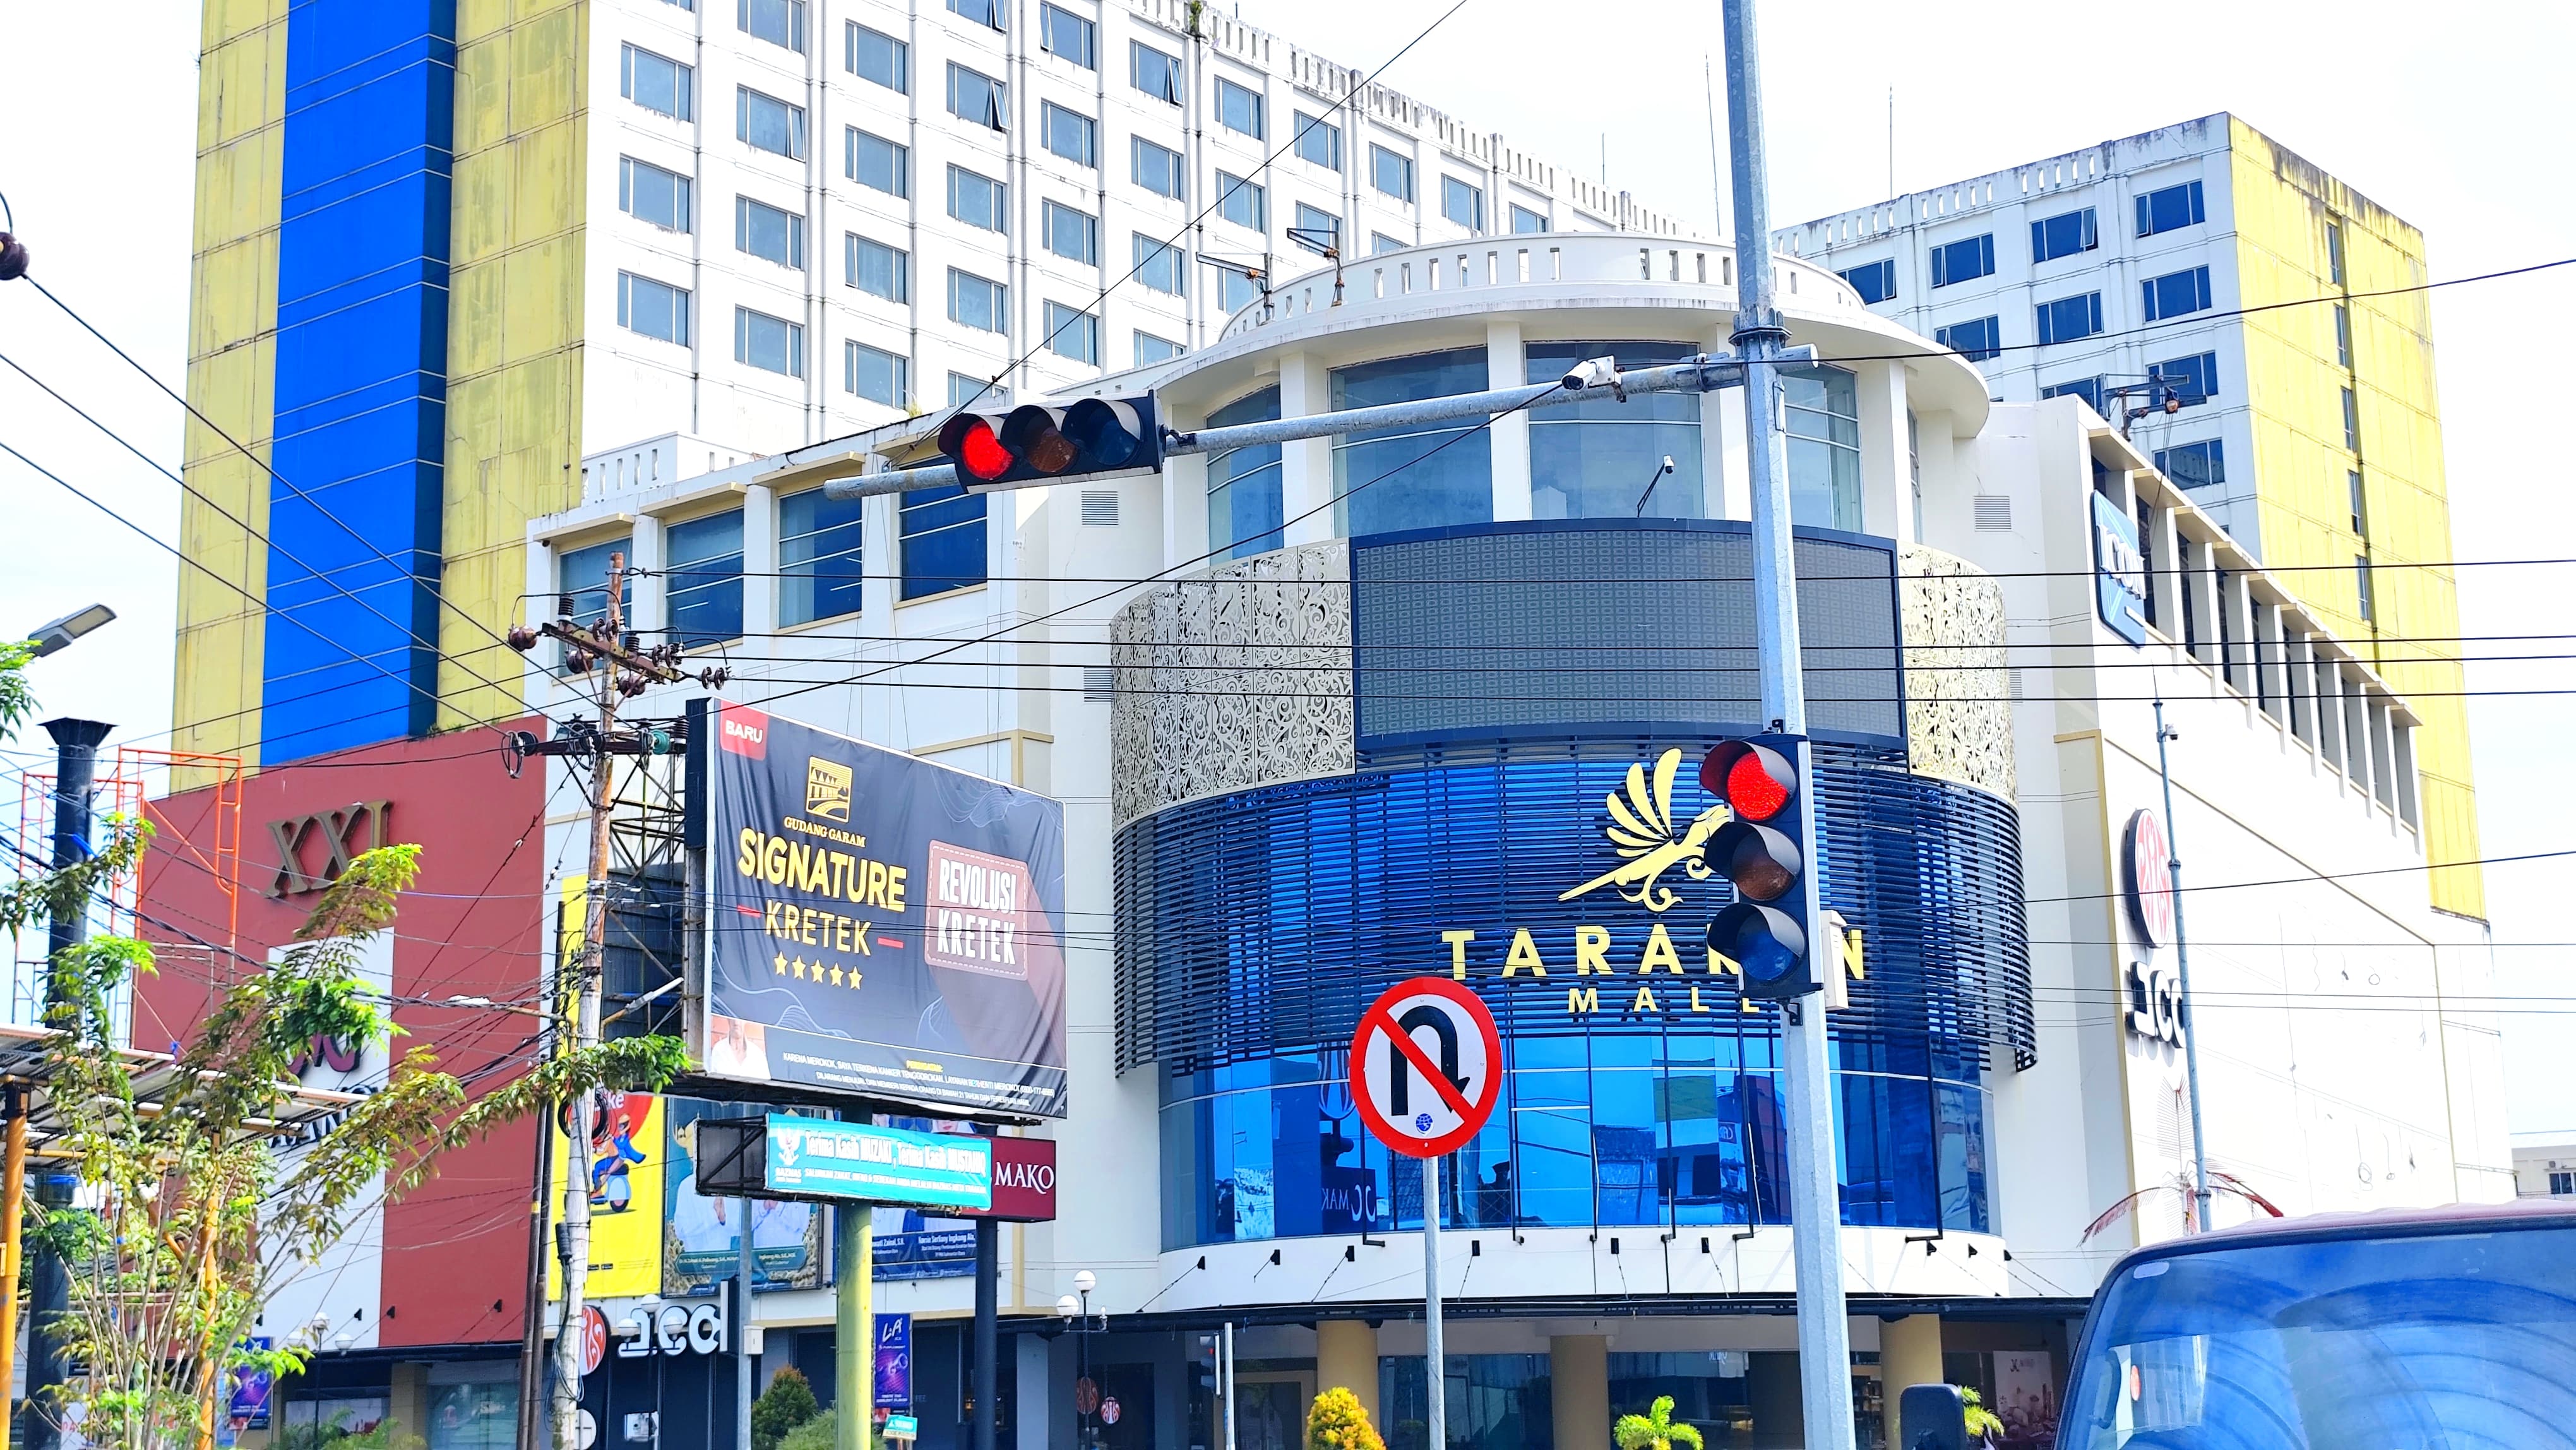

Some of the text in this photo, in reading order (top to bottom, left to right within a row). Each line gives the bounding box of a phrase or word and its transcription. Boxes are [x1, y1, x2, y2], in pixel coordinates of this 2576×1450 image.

[725, 719, 763, 743] BARU
[266, 800, 392, 898] XXI
[784, 816, 866, 848] GUDANG GARAM
[738, 827, 907, 913] SIGNATURE
[939, 857, 1016, 915] REVOLUSI
[765, 899, 871, 956] KRETEK
[938, 908, 1016, 964] KRETEK
[1442, 923, 1864, 980] TARAN
[1568, 986, 1759, 1013] MALL
[784, 1052, 807, 1064] KARENA
[837, 1060, 852, 1071] SAYA
[806, 1130, 834, 1158] Terima
[836, 1134, 859, 1161] Kasih
[897, 1141, 924, 1168] Terima
[925, 1146, 946, 1170] Kasih
[995, 1161, 1054, 1194] MAKO
